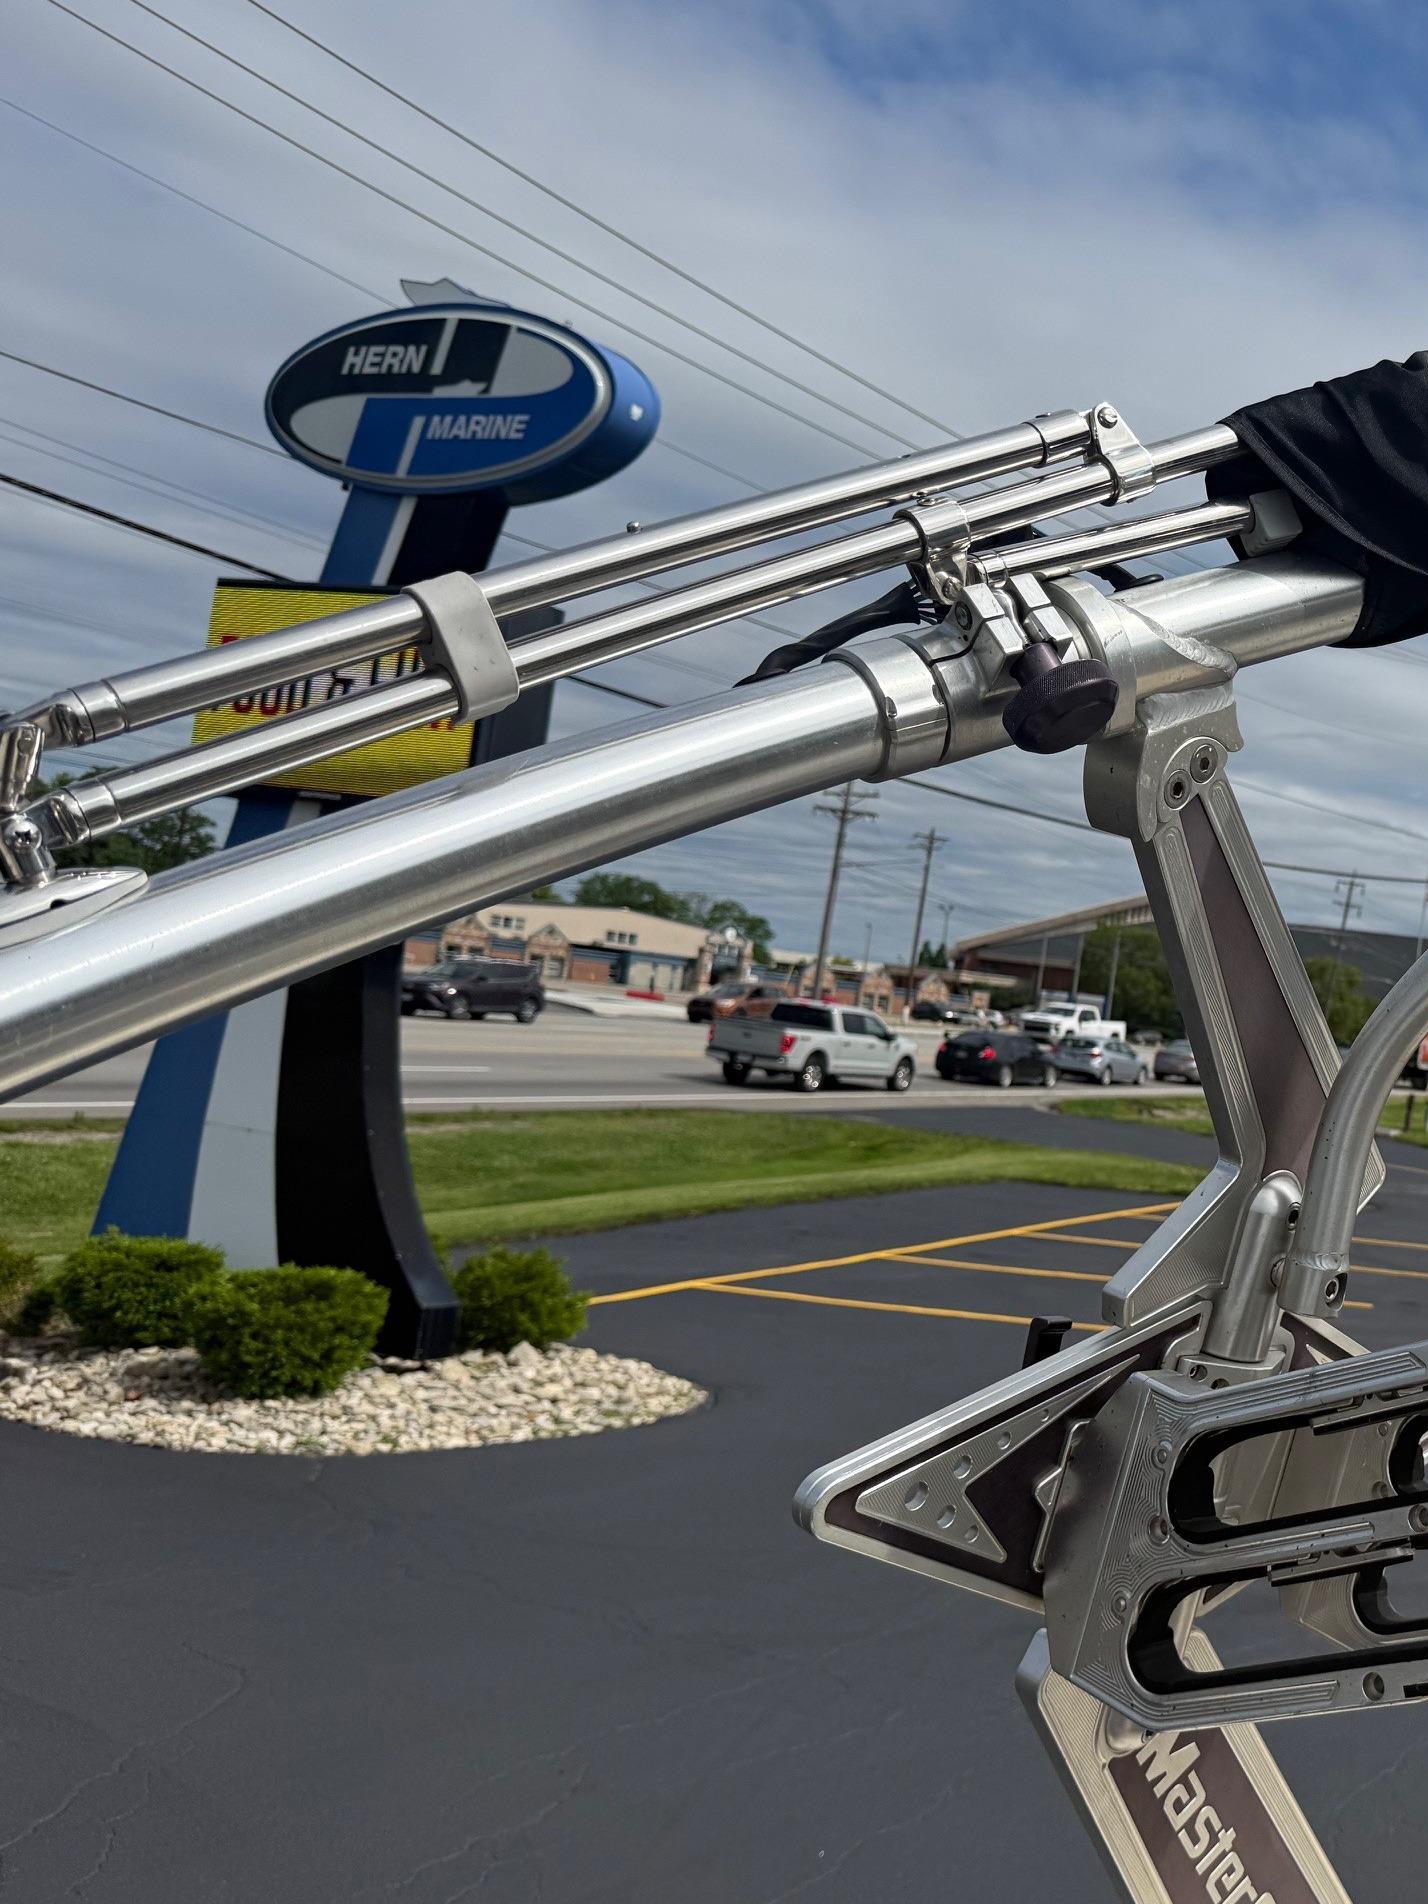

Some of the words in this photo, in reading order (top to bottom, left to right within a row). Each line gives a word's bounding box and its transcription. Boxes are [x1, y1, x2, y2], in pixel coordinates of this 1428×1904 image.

[340, 344, 428, 375] HERN
[426, 414, 530, 440] MARINE
[1136, 1732, 1275, 1904] Master
